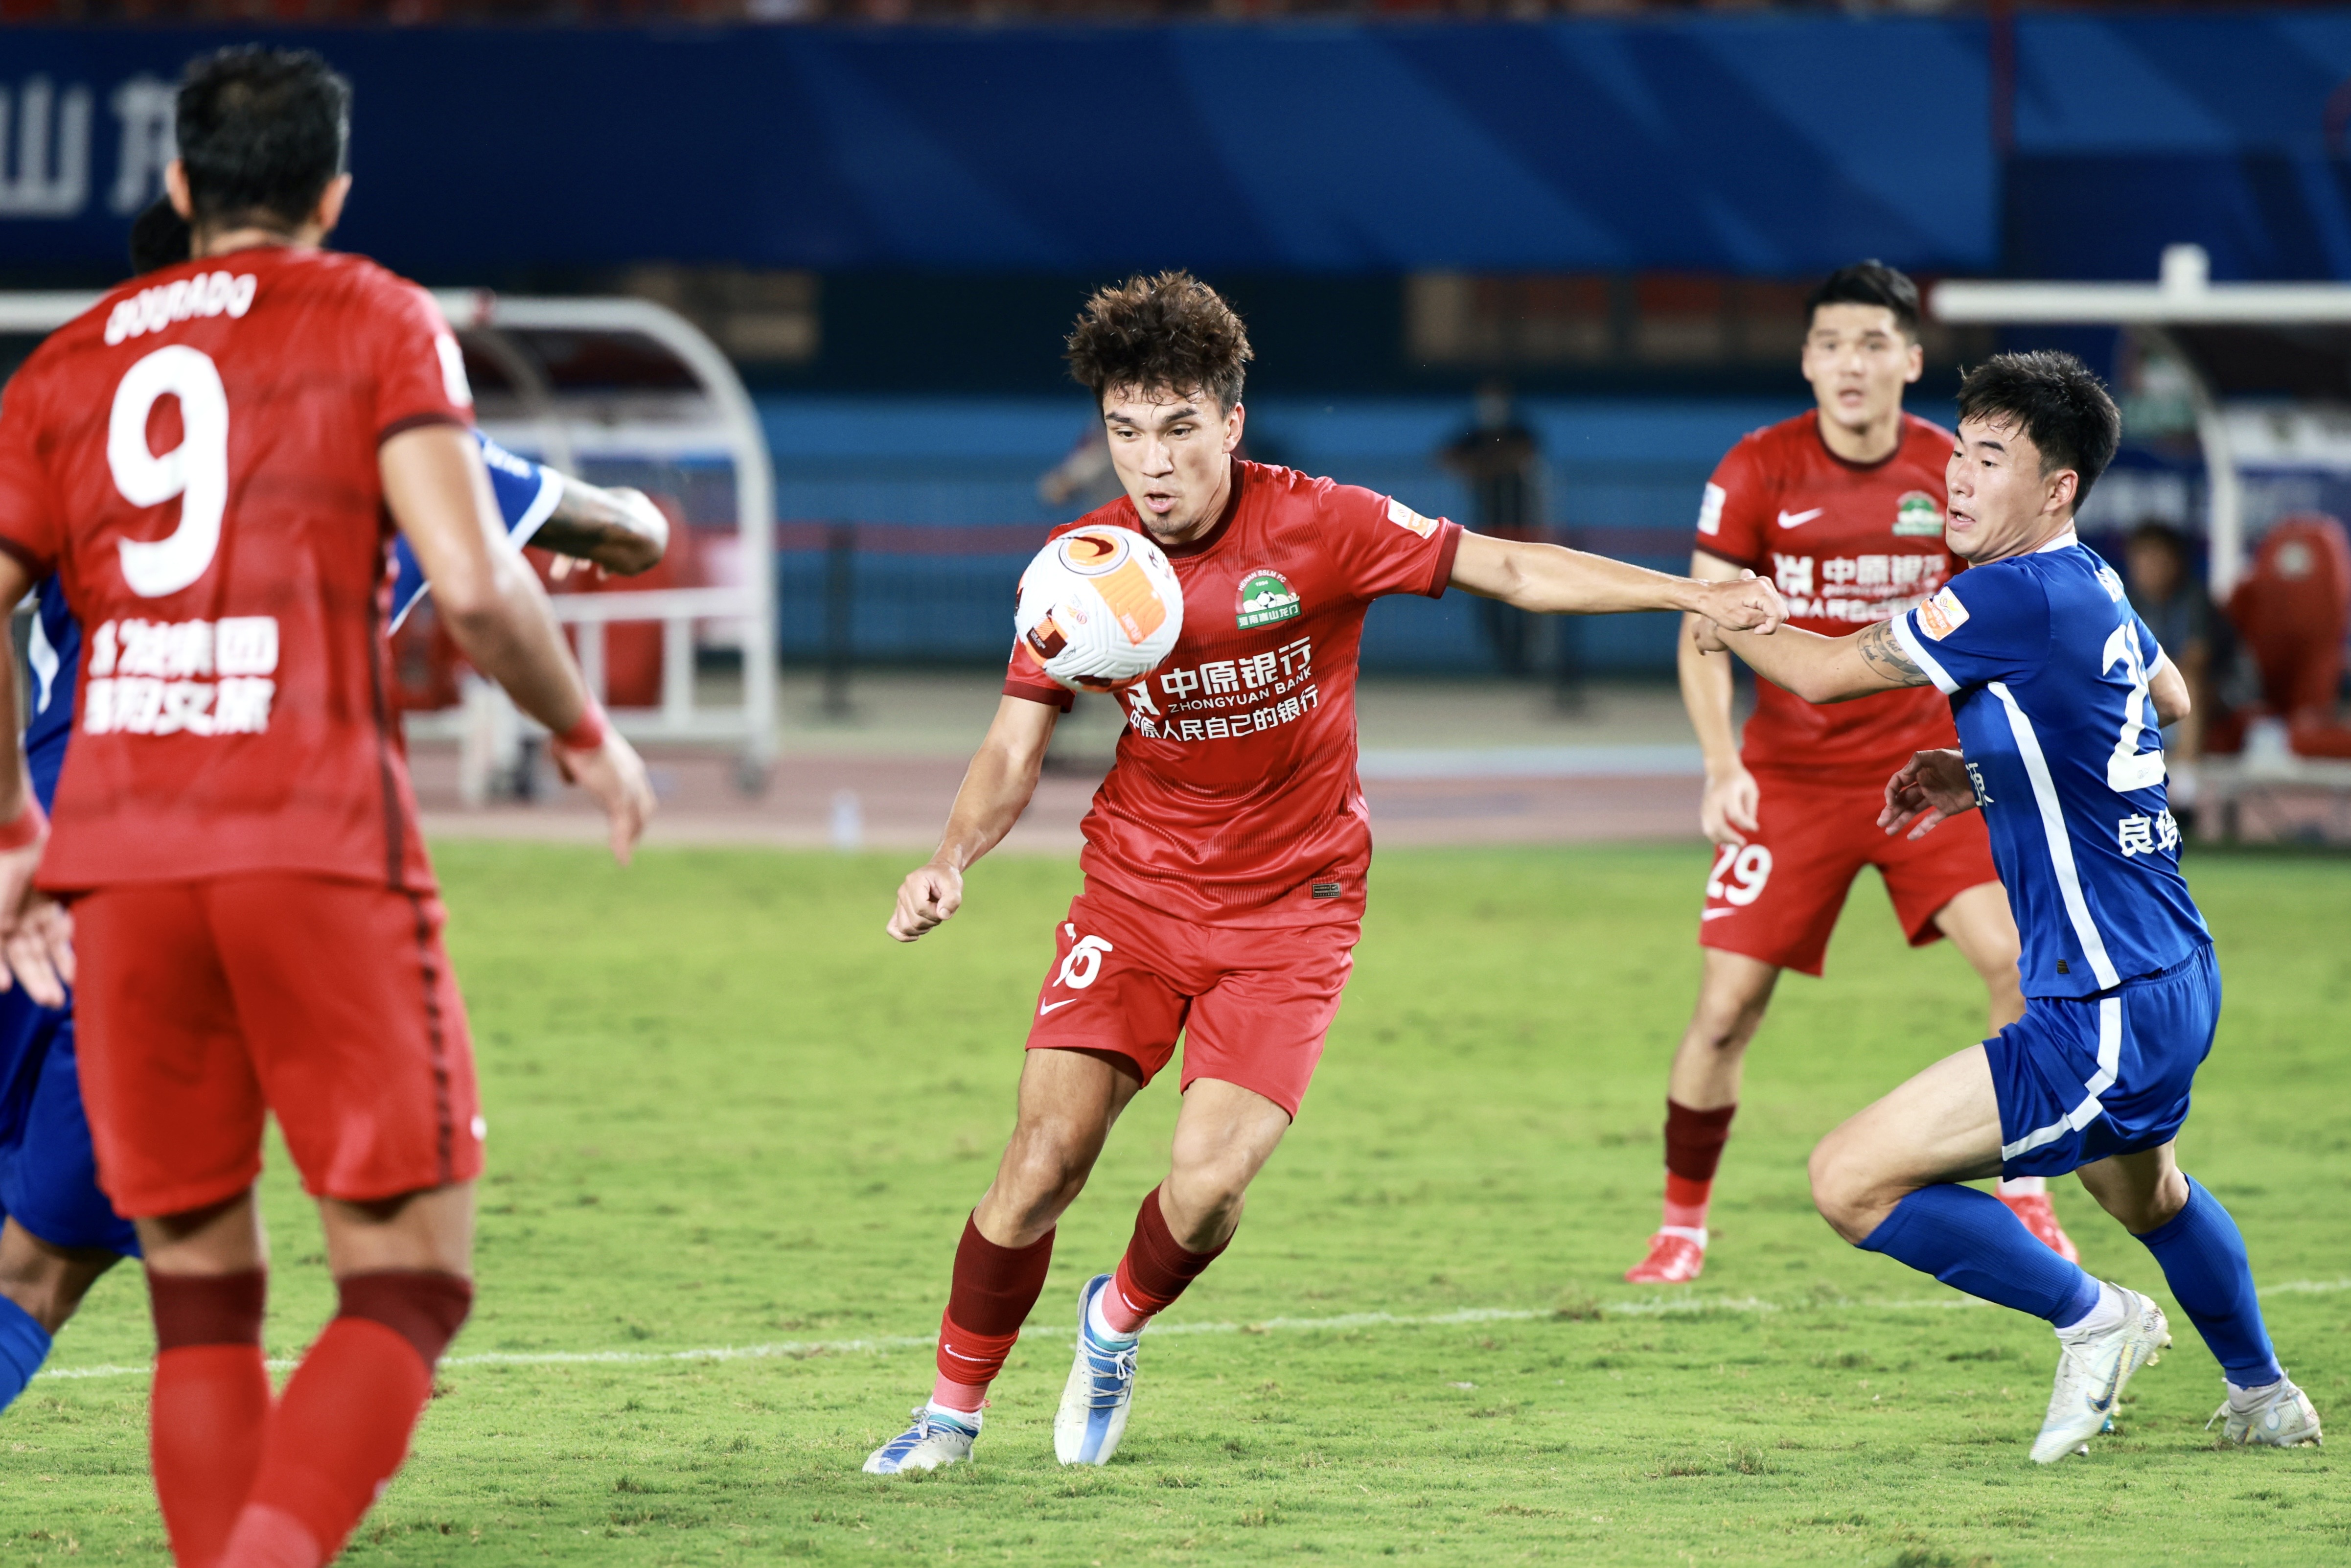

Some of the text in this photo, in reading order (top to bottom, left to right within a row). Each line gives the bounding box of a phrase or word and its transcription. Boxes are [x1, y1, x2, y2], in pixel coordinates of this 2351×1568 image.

[107, 344, 229, 598] 9
[1238, 572, 1257, 592] HENAN
[1277, 574, 1287, 583] FC
[1239, 604, 1299, 627] 河南嵩山龙门
[1160, 636, 1312, 700] 中原银行
[1168, 666, 1312, 714] ZHONGYUAN BANK
[1129, 684, 1319, 742] 中原人民自己的银行
[2102, 618, 2167, 793] 2
[1706, 843, 1773, 906] 29
